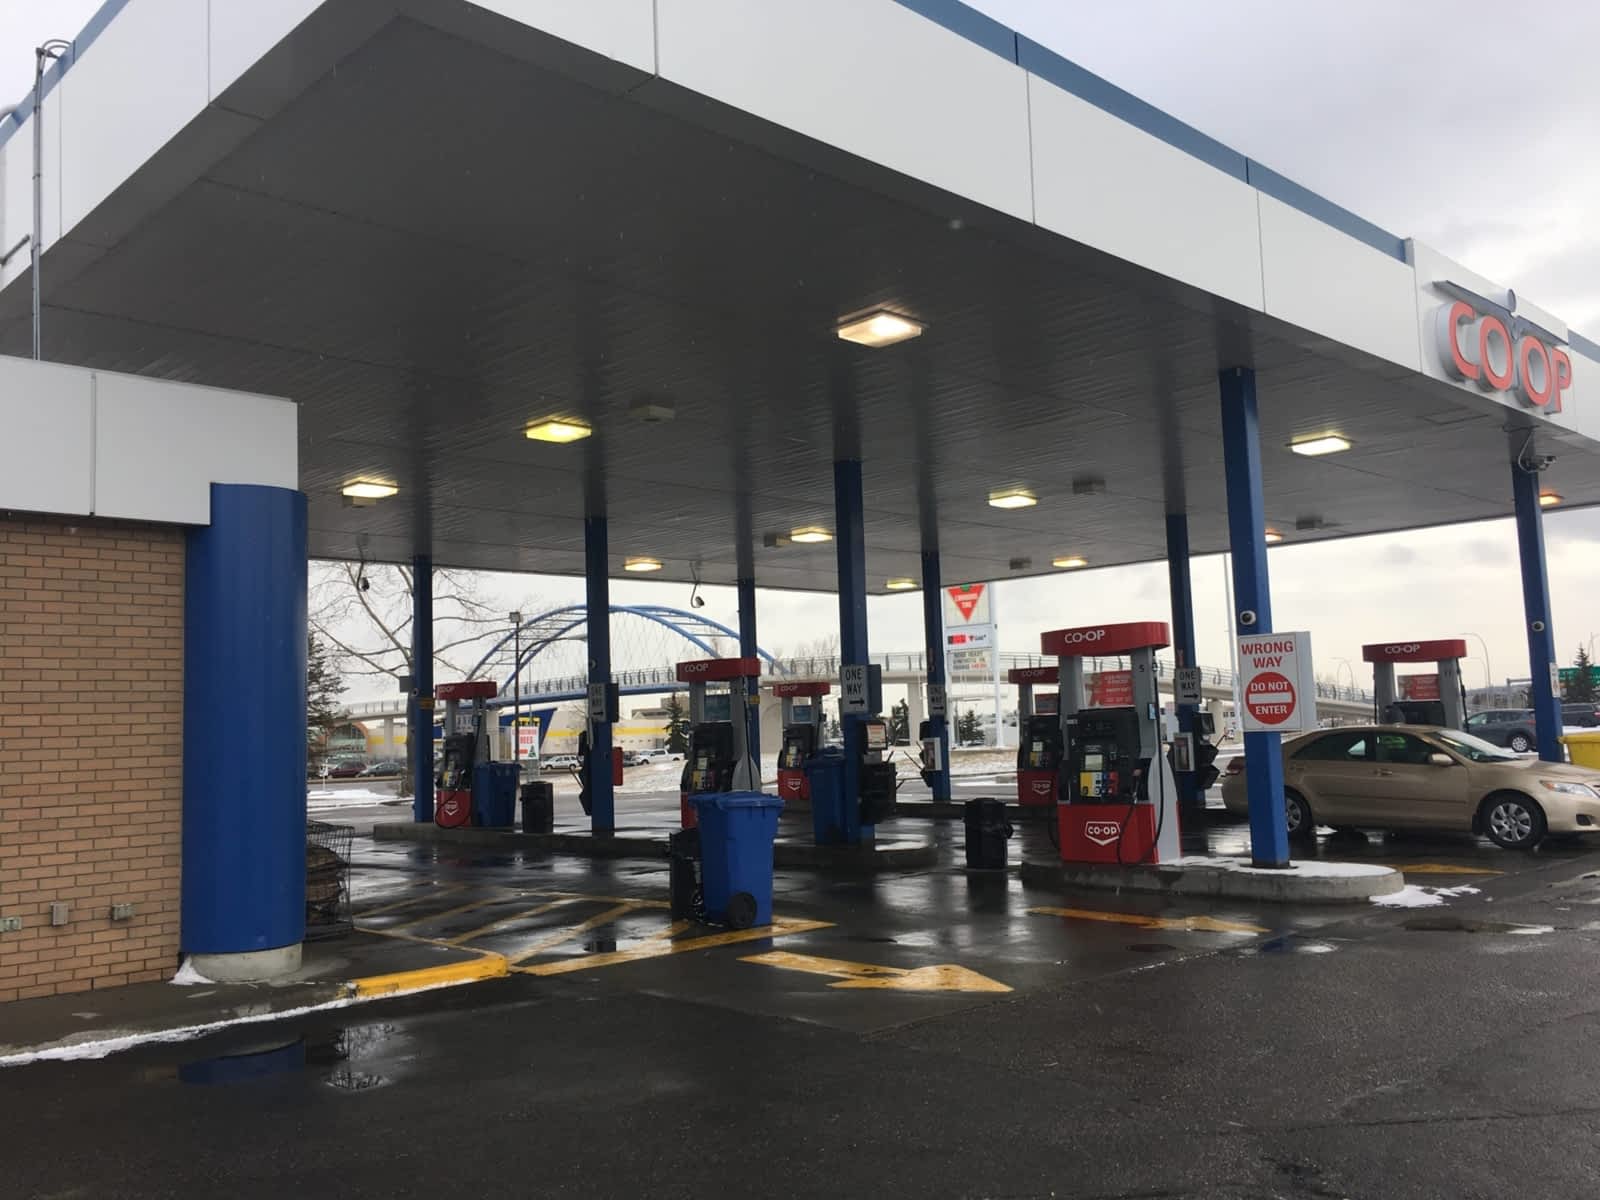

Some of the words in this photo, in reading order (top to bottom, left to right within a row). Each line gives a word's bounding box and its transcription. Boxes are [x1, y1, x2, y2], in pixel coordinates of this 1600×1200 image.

[1064, 630, 1105, 643] CO-OP
[1241, 640, 1294, 655] WRONG
[1384, 644, 1421, 654] CO-OP
[685, 663, 709, 673] CO-OP
[1253, 656, 1283, 669] WAY
[845, 668, 863, 681] ONE
[1180, 670, 1196, 680] ONE
[846, 683, 863, 695] WAY
[1251, 682, 1266, 692] DO
[1268, 681, 1289, 691] NOT
[1255, 705, 1287, 715] ENTER
[1087, 826, 1117, 835] CO-OP
